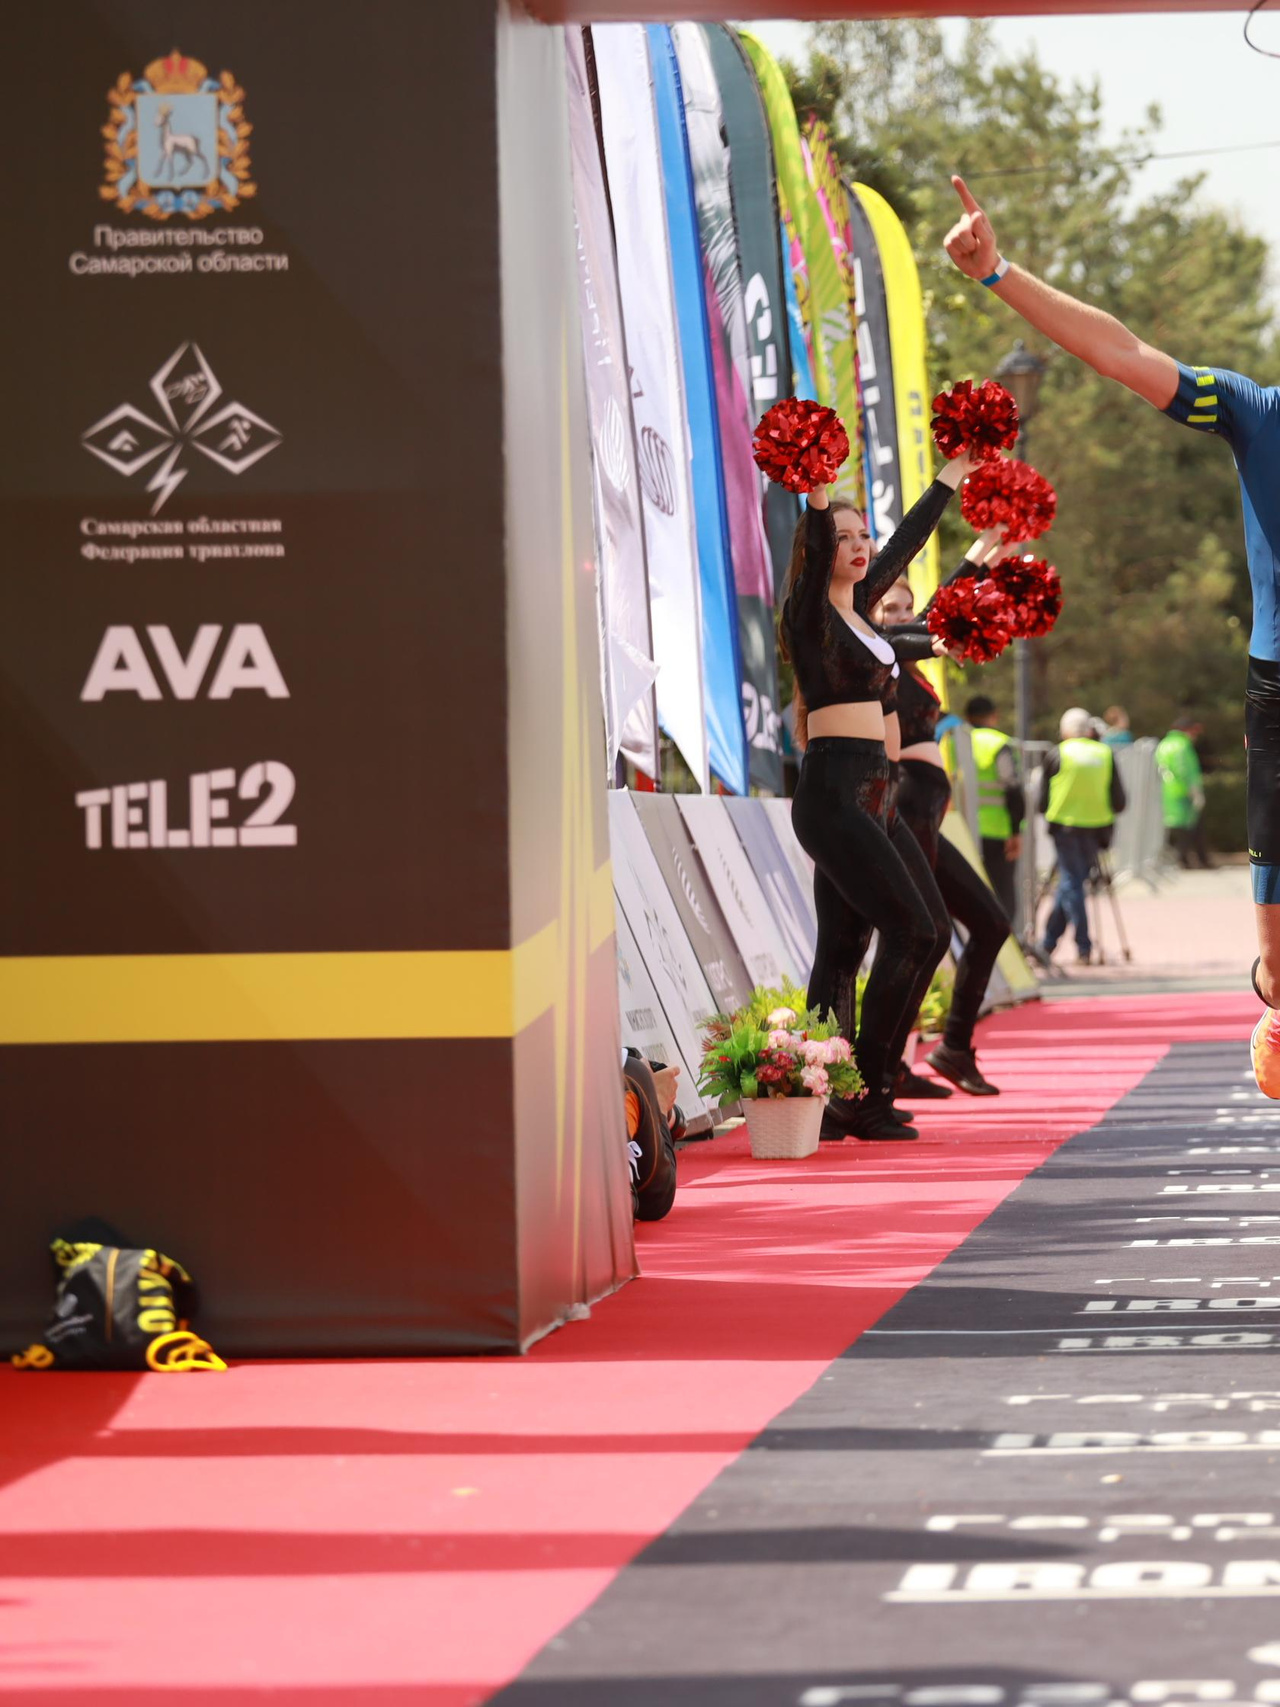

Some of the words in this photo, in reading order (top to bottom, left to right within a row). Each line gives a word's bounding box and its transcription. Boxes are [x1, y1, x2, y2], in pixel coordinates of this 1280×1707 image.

[94, 224, 263, 250] Правительство
[69, 251, 193, 277] Самарской
[197, 249, 289, 272] области
[80, 517, 183, 539] Самарская
[187, 516, 283, 533] областная
[80, 542, 184, 563] Федерация
[189, 543, 285, 562] триатлона
[80, 624, 290, 701] AVA
[75, 761, 297, 849] TELE2
